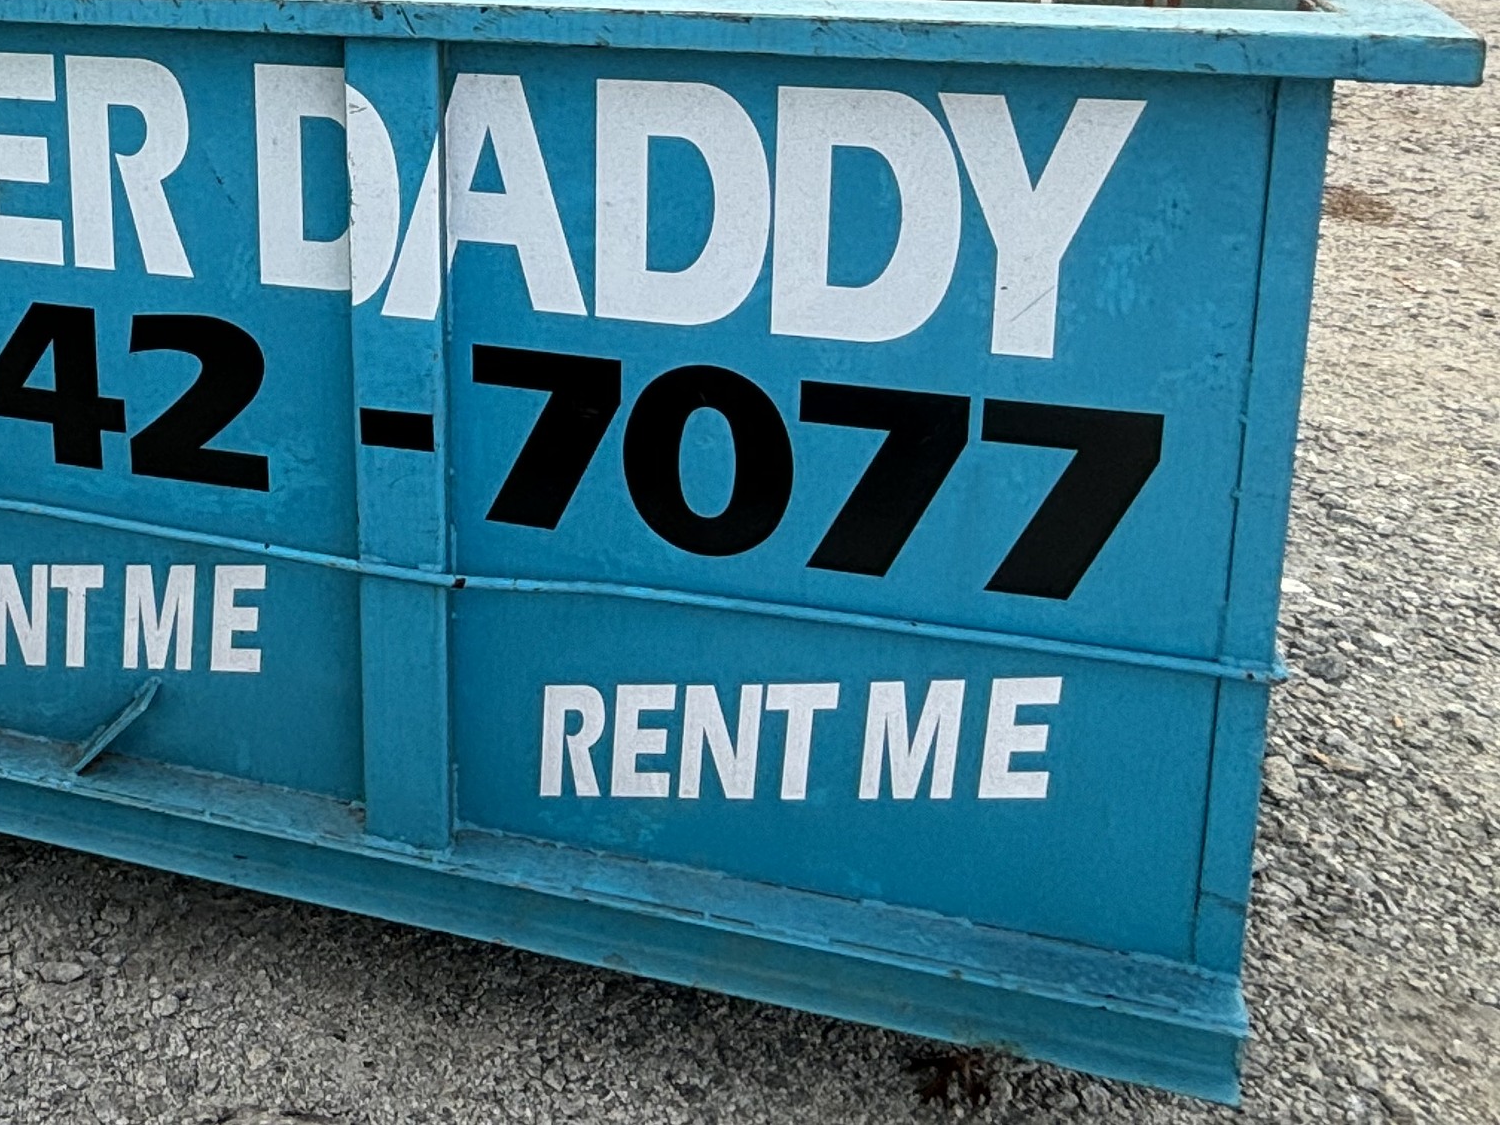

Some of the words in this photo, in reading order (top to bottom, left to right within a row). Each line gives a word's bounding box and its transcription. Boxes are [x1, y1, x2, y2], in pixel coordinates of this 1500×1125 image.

[254, 63, 1147, 359] DADDY
[122, 564, 266, 673] ME
[539, 682, 841, 801] RENT
[858, 676, 1063, 800] ME
